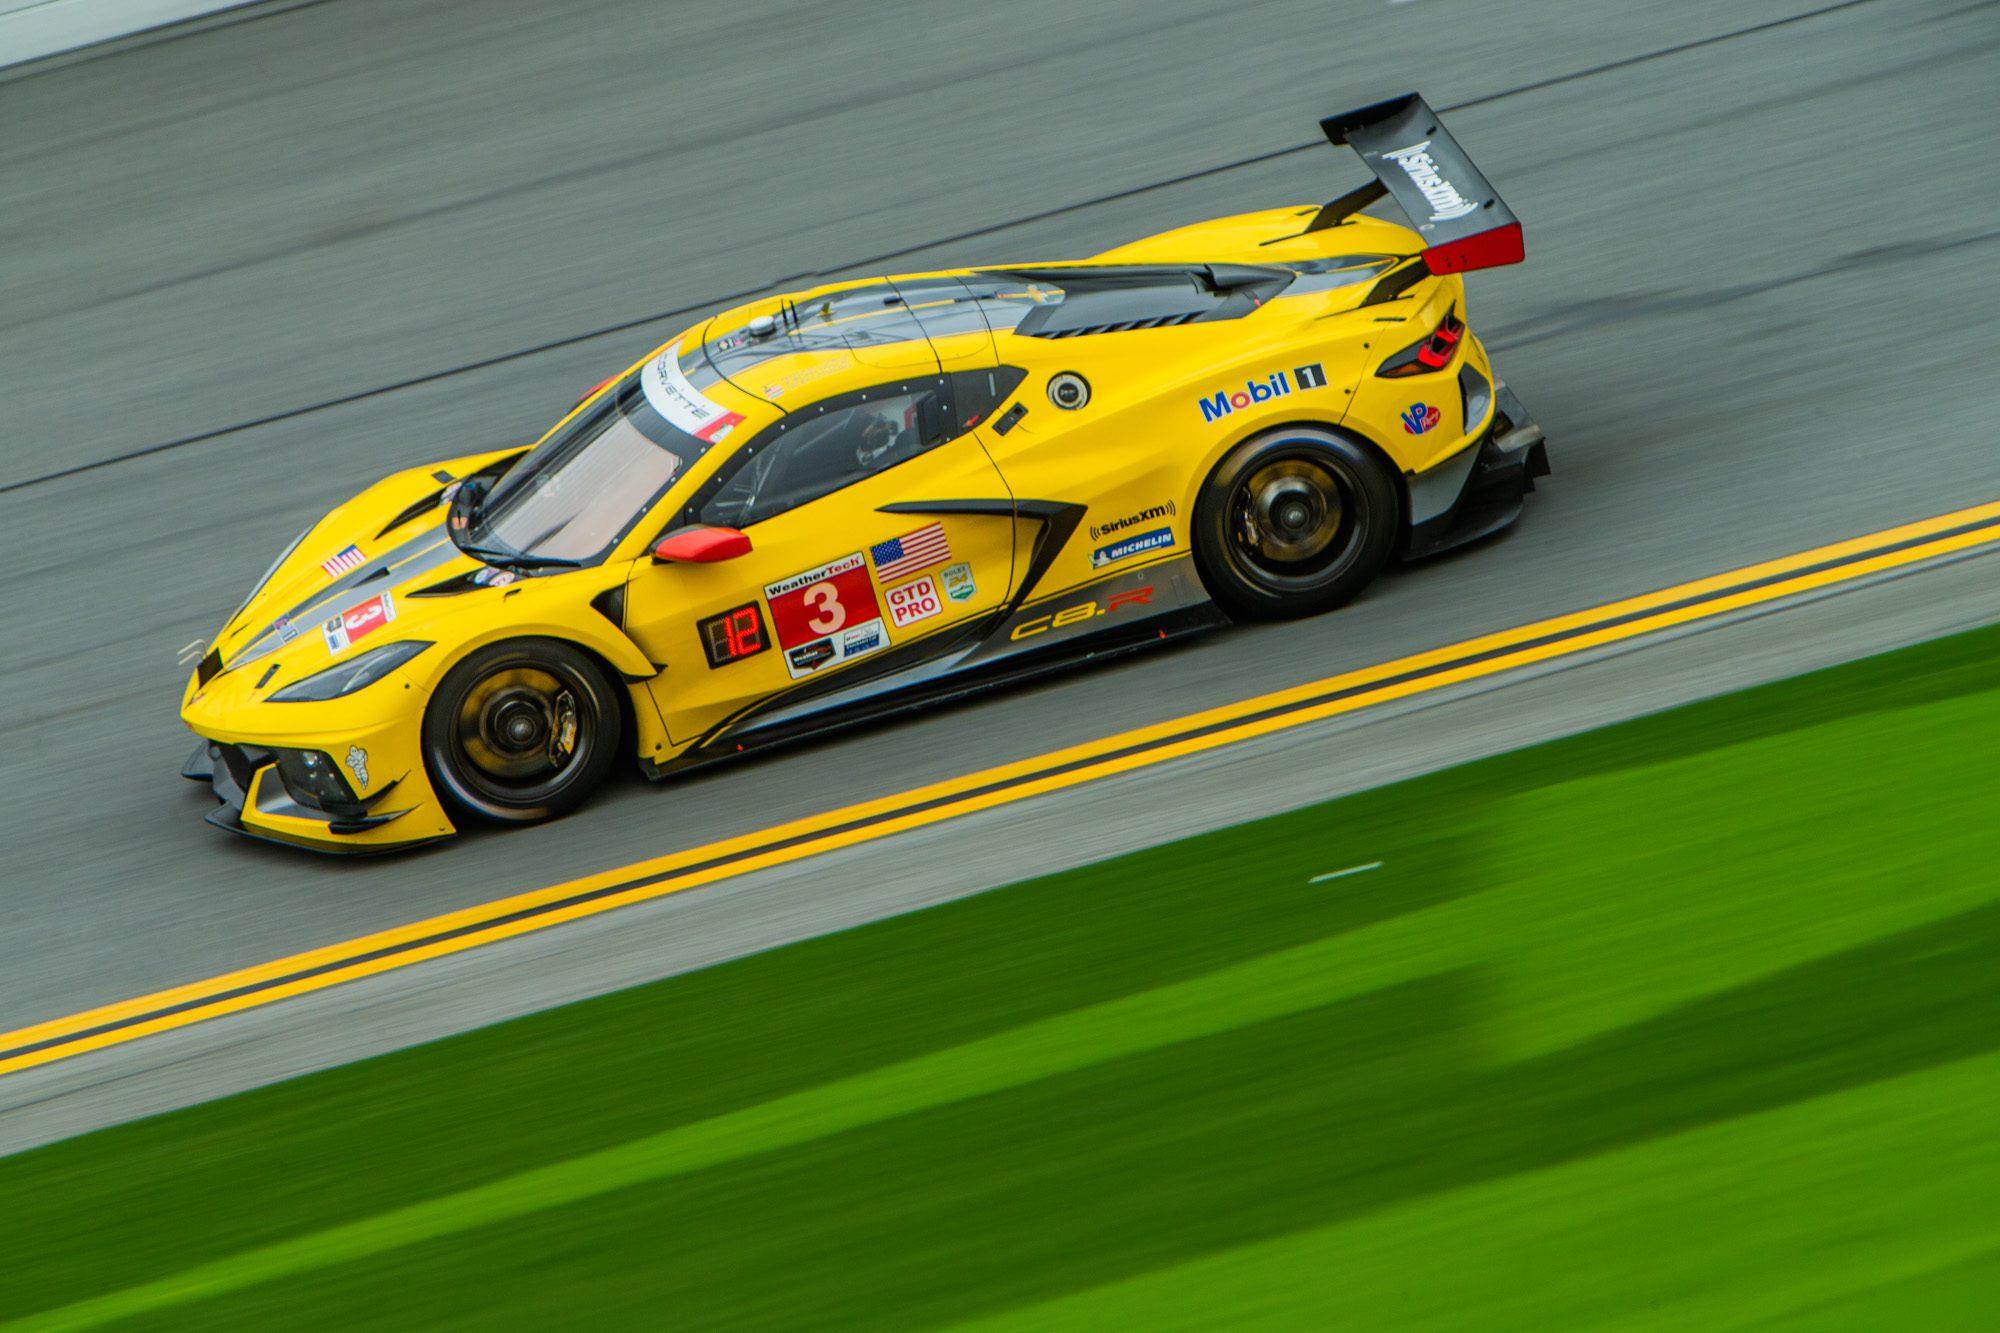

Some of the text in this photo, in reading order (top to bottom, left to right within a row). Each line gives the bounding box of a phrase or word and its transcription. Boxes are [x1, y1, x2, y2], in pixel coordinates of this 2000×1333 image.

[657, 353, 710, 419] CORVETTE
[1199, 371, 1290, 423] Mobil
[1400, 402, 1428, 434] VP
[1111, 533, 1172, 558] MICHELIN
[769, 558, 861, 595] WeatherTech
[943, 566, 966, 577] ROLEX
[803, 581, 846, 635] 3
[890, 581, 931, 606] GTD
[895, 597, 936, 622] PRO
[345, 605, 382, 630] 3
[1010, 586, 1153, 641] C8.R
[723, 607, 761, 657] 12
